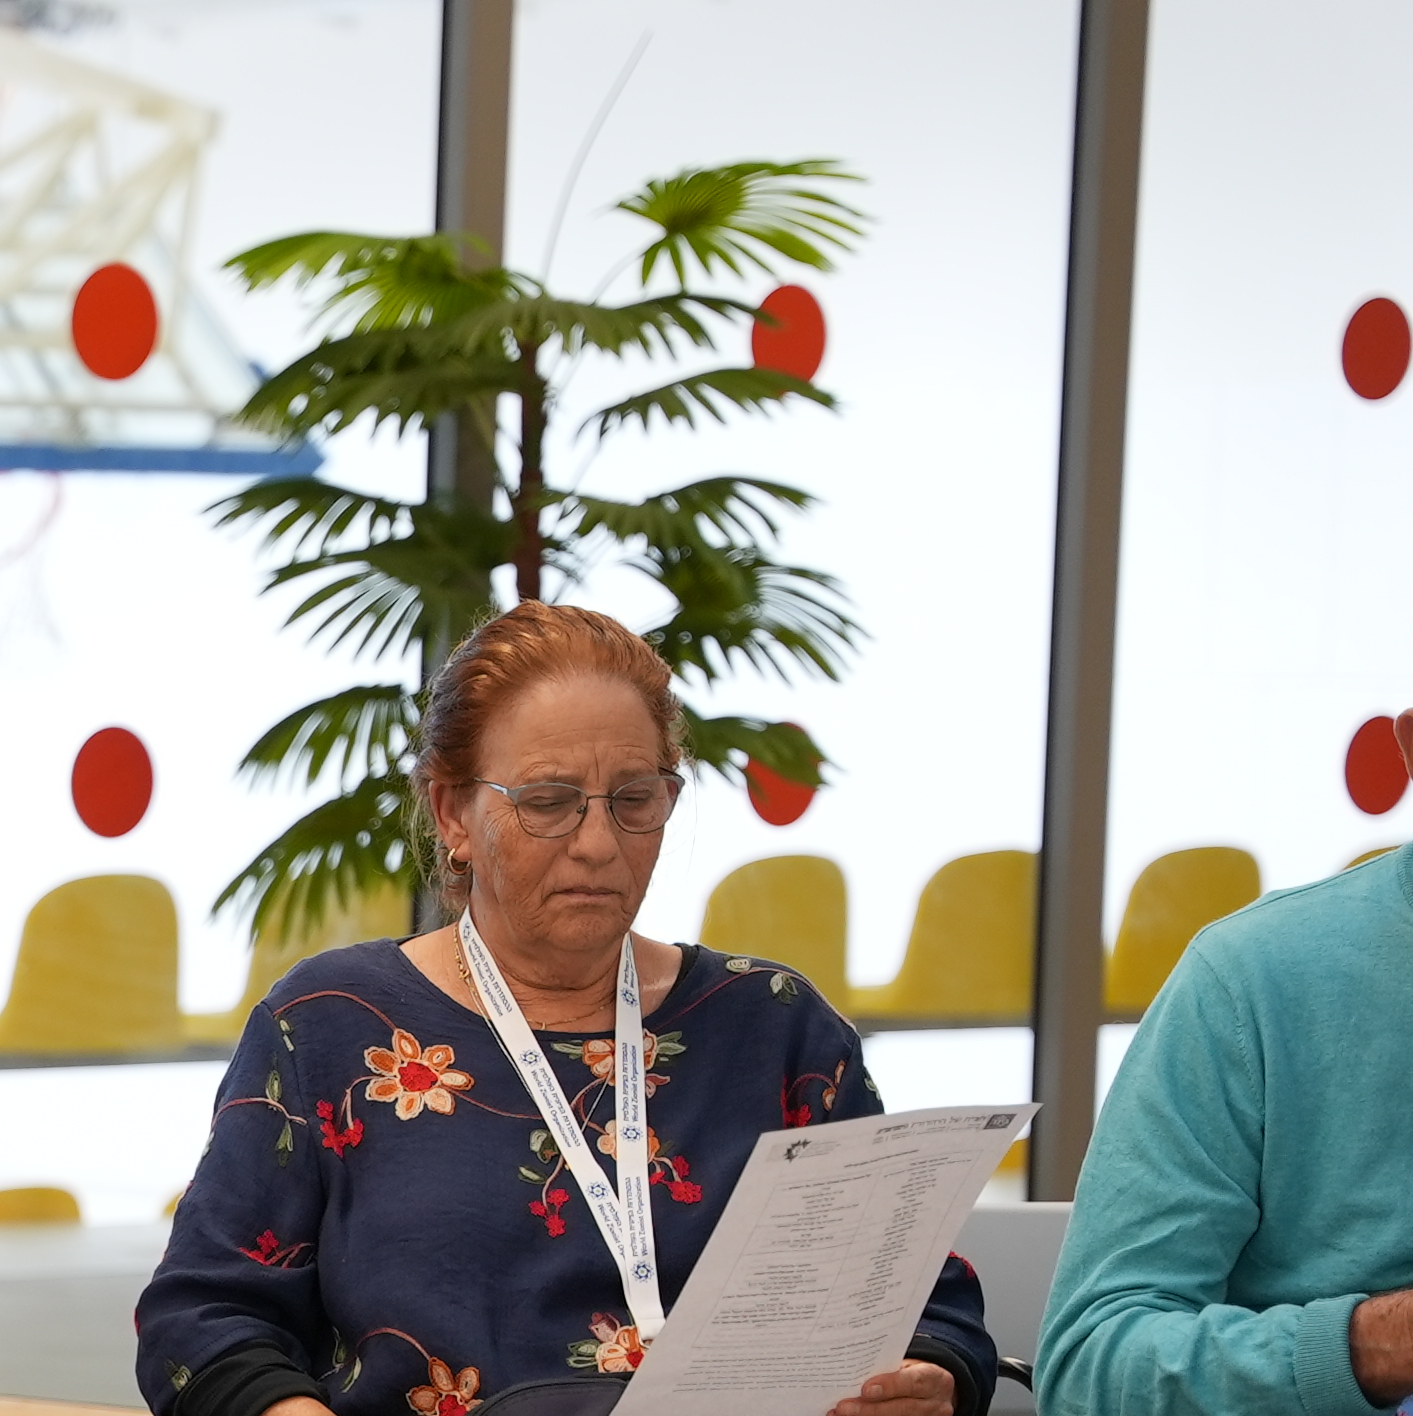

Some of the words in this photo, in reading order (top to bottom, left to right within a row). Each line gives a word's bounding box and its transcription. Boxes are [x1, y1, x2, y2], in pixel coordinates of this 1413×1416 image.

[482, 980, 503, 1017] Organization
[631, 1045, 639, 1082] Organization
[531, 1069, 544, 1088] World
[540, 1087, 554, 1109] Zionist
[550, 1109, 571, 1148] Organization
[635, 1176, 644, 1215] Organization
[637, 1215, 645, 1236] Zionist
[640, 1236, 648, 1256] World
